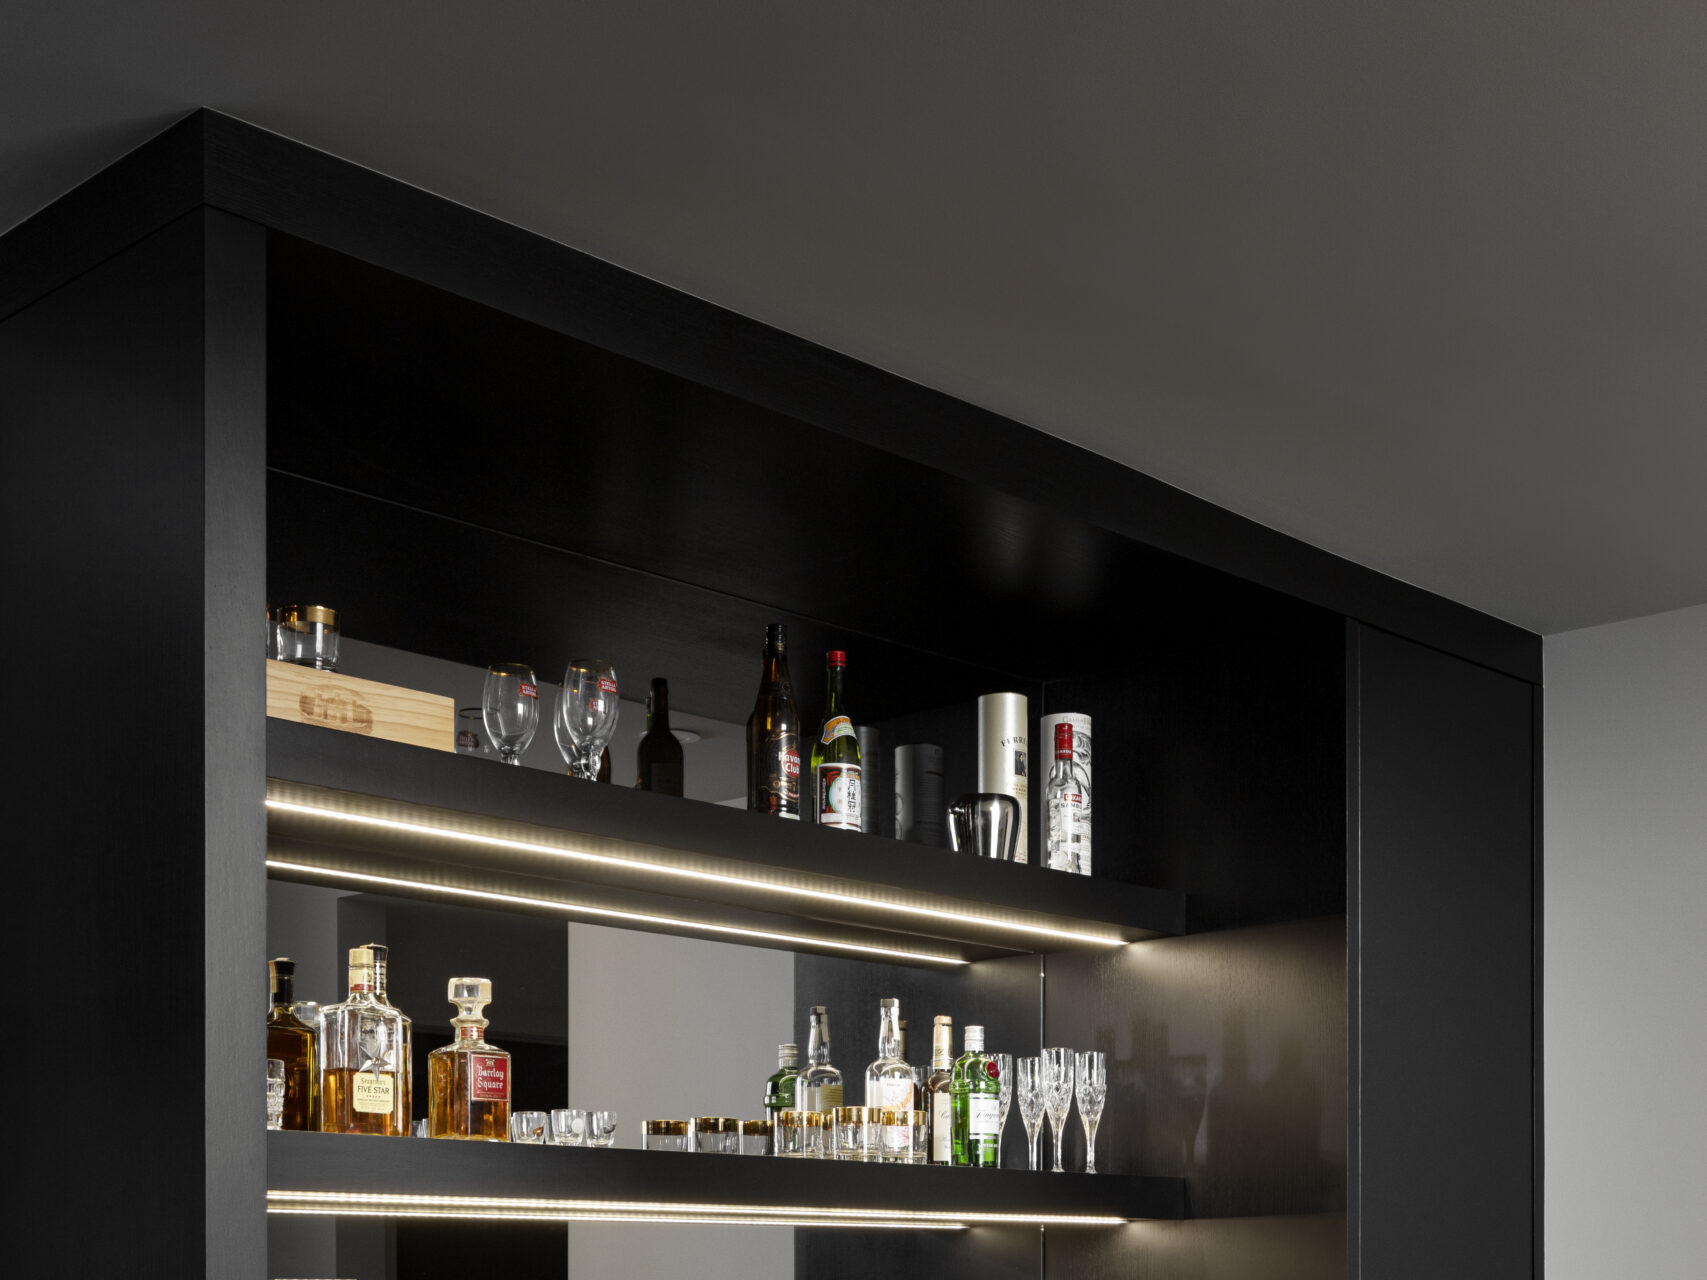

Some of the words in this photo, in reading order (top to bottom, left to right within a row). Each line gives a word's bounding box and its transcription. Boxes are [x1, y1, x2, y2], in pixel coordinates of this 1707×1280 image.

[779, 751, 800, 764] Havan
[357, 1086, 372, 1094] FIVE
[373, 1086, 390, 1095] STAR
